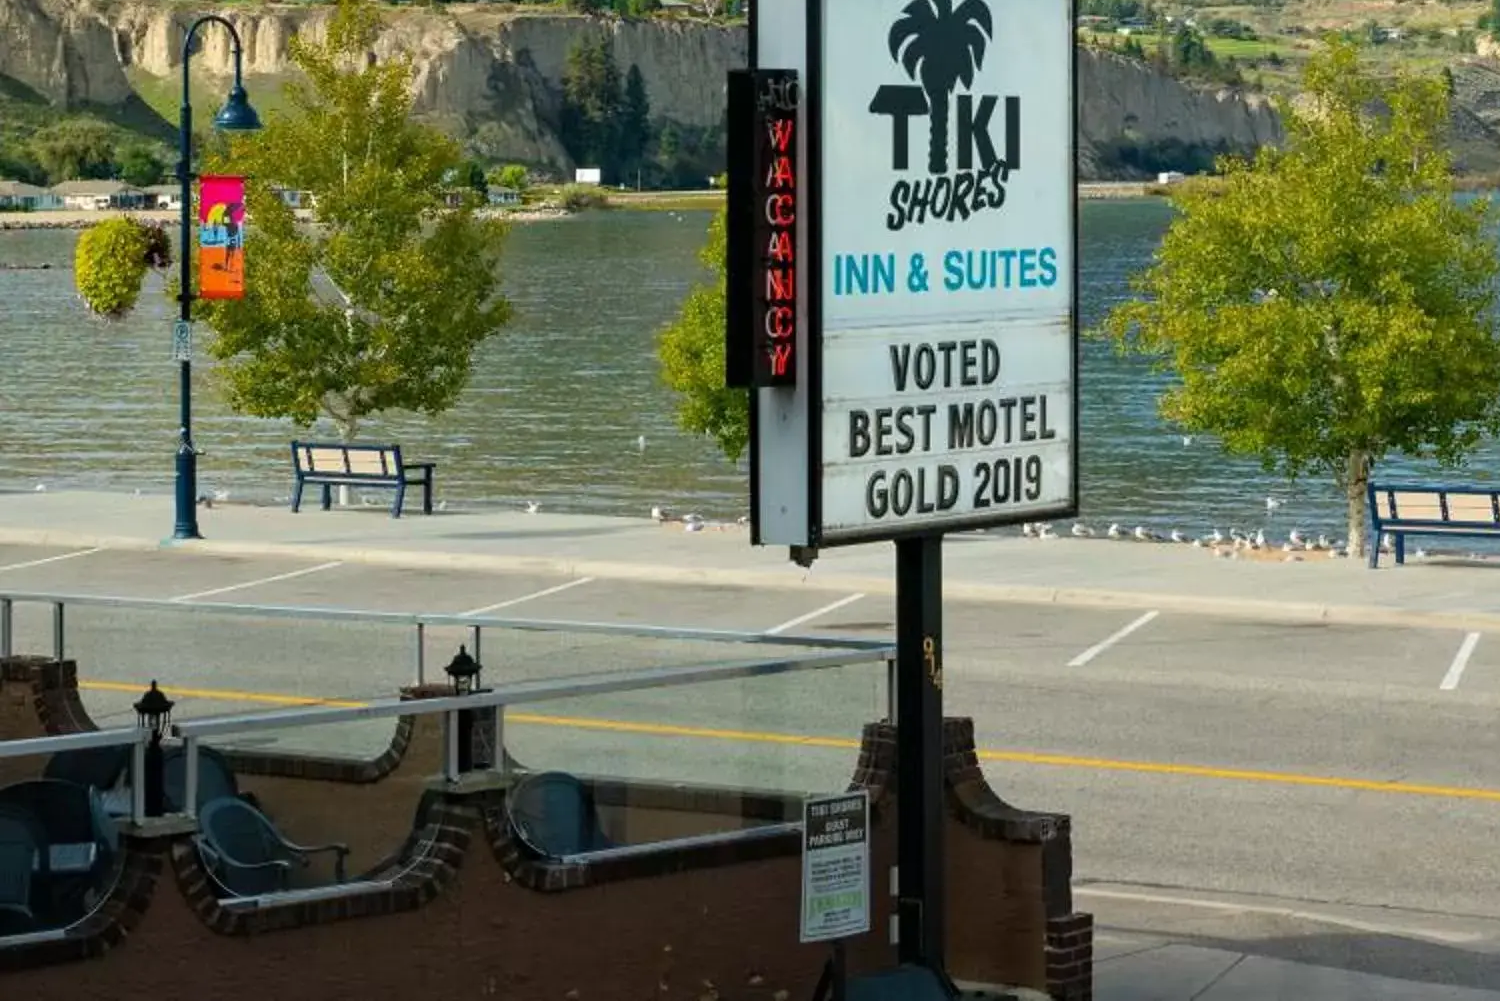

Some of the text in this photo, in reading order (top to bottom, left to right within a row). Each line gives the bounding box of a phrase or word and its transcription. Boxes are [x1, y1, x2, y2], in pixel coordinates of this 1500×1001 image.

[868, 84, 1021, 174] TIKI
[886, 158, 1009, 232] SHORES
[767, 118, 795, 377] VACANCY
[834, 247, 1057, 295] INN & SUITES
[889, 338, 1001, 392] VOTED
[849, 394, 1056, 458] BEST MOTEL
[866, 454, 1042, 519] GOLD 2019
